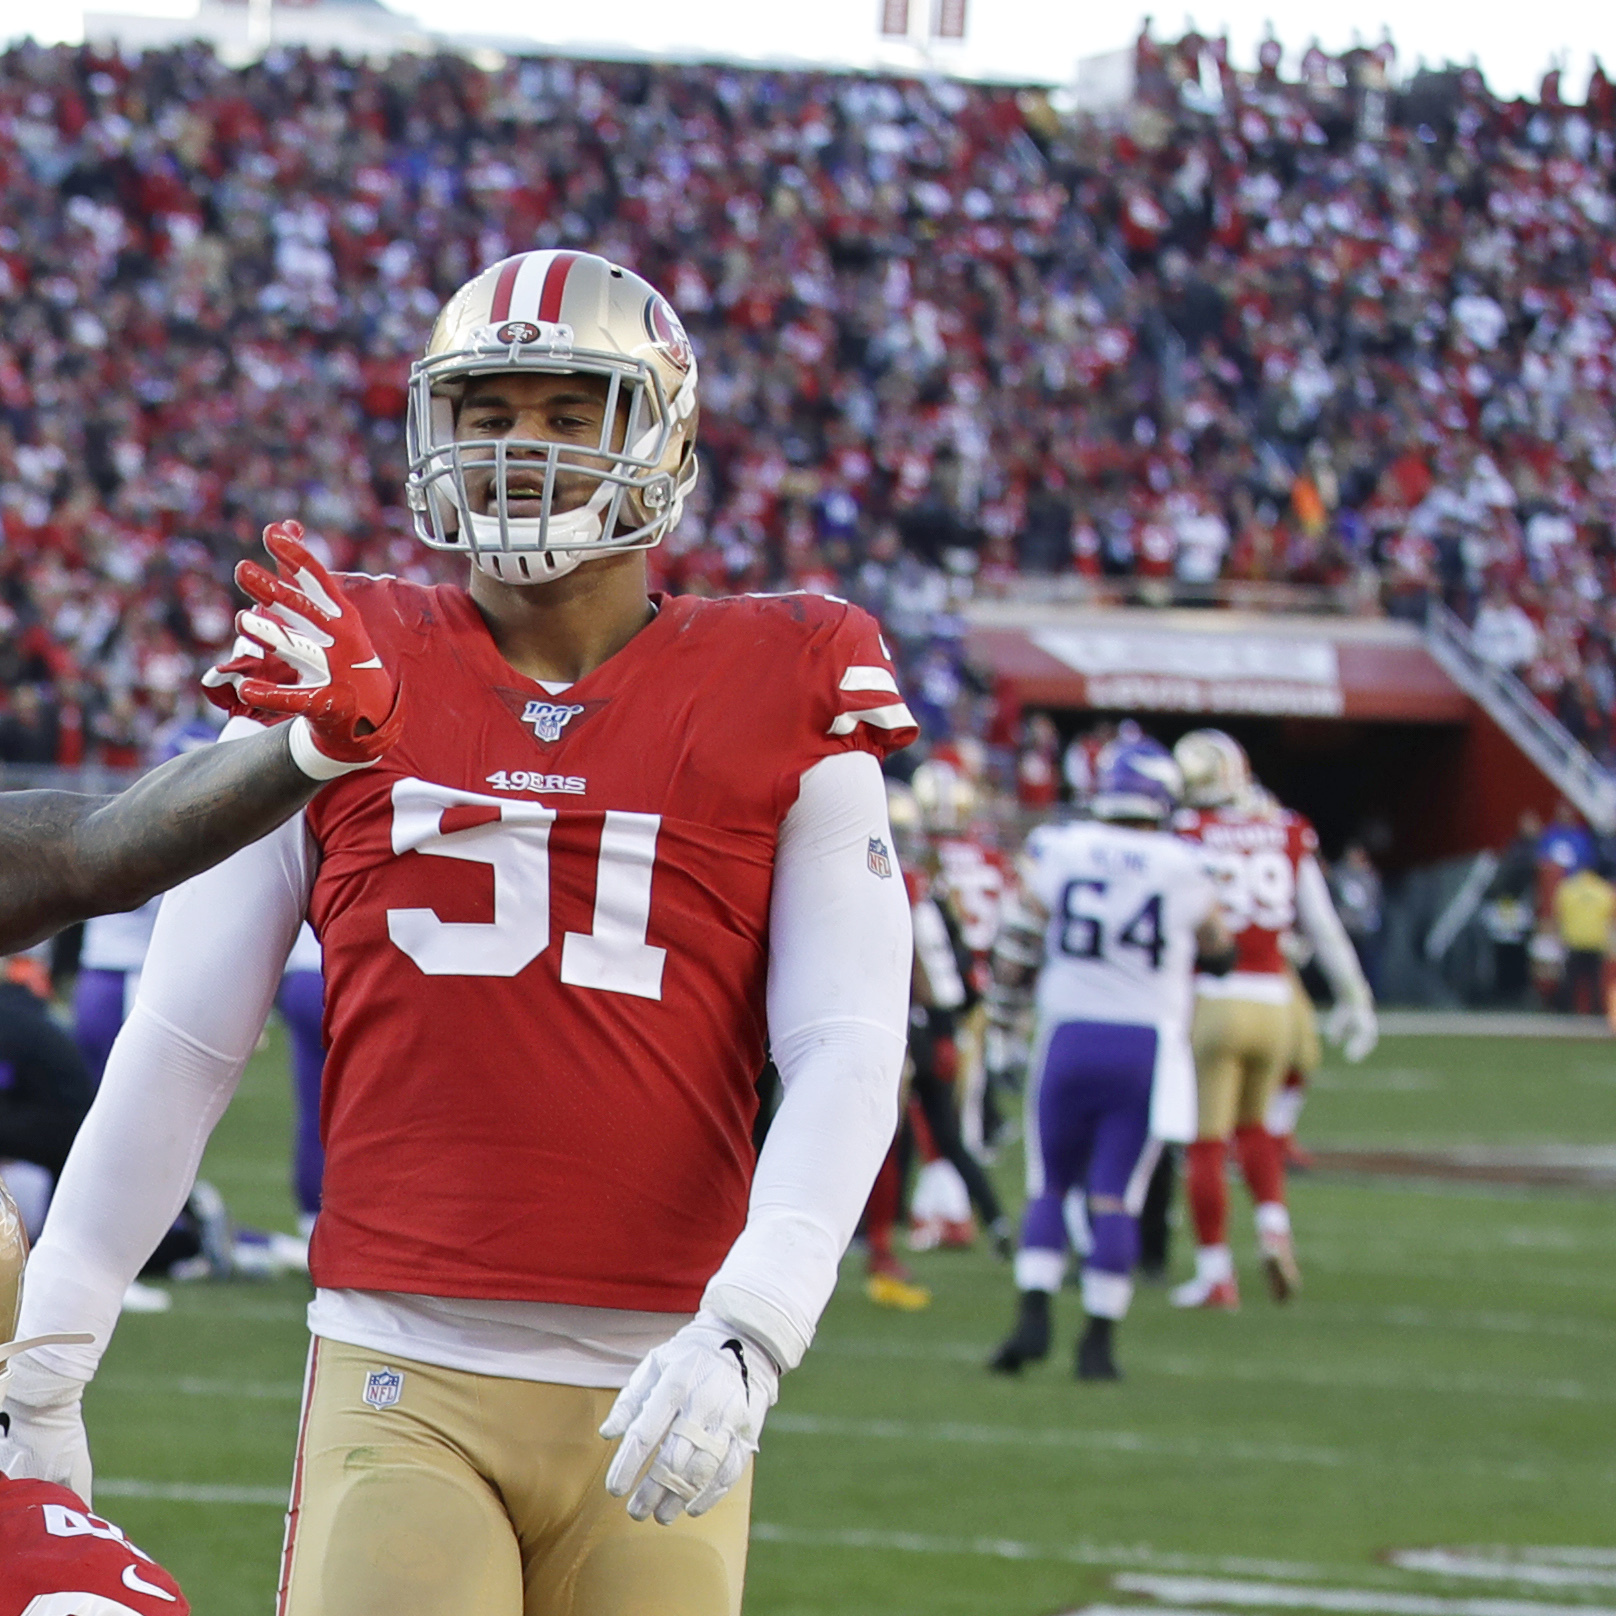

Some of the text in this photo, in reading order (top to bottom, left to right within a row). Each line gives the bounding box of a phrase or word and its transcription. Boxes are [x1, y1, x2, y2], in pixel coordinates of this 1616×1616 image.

[485, 769, 587, 796] 49ERS
[386, 778, 668, 1001] 91
[869, 851, 889, 876] NFL
[1056, 876, 1167, 970] 64
